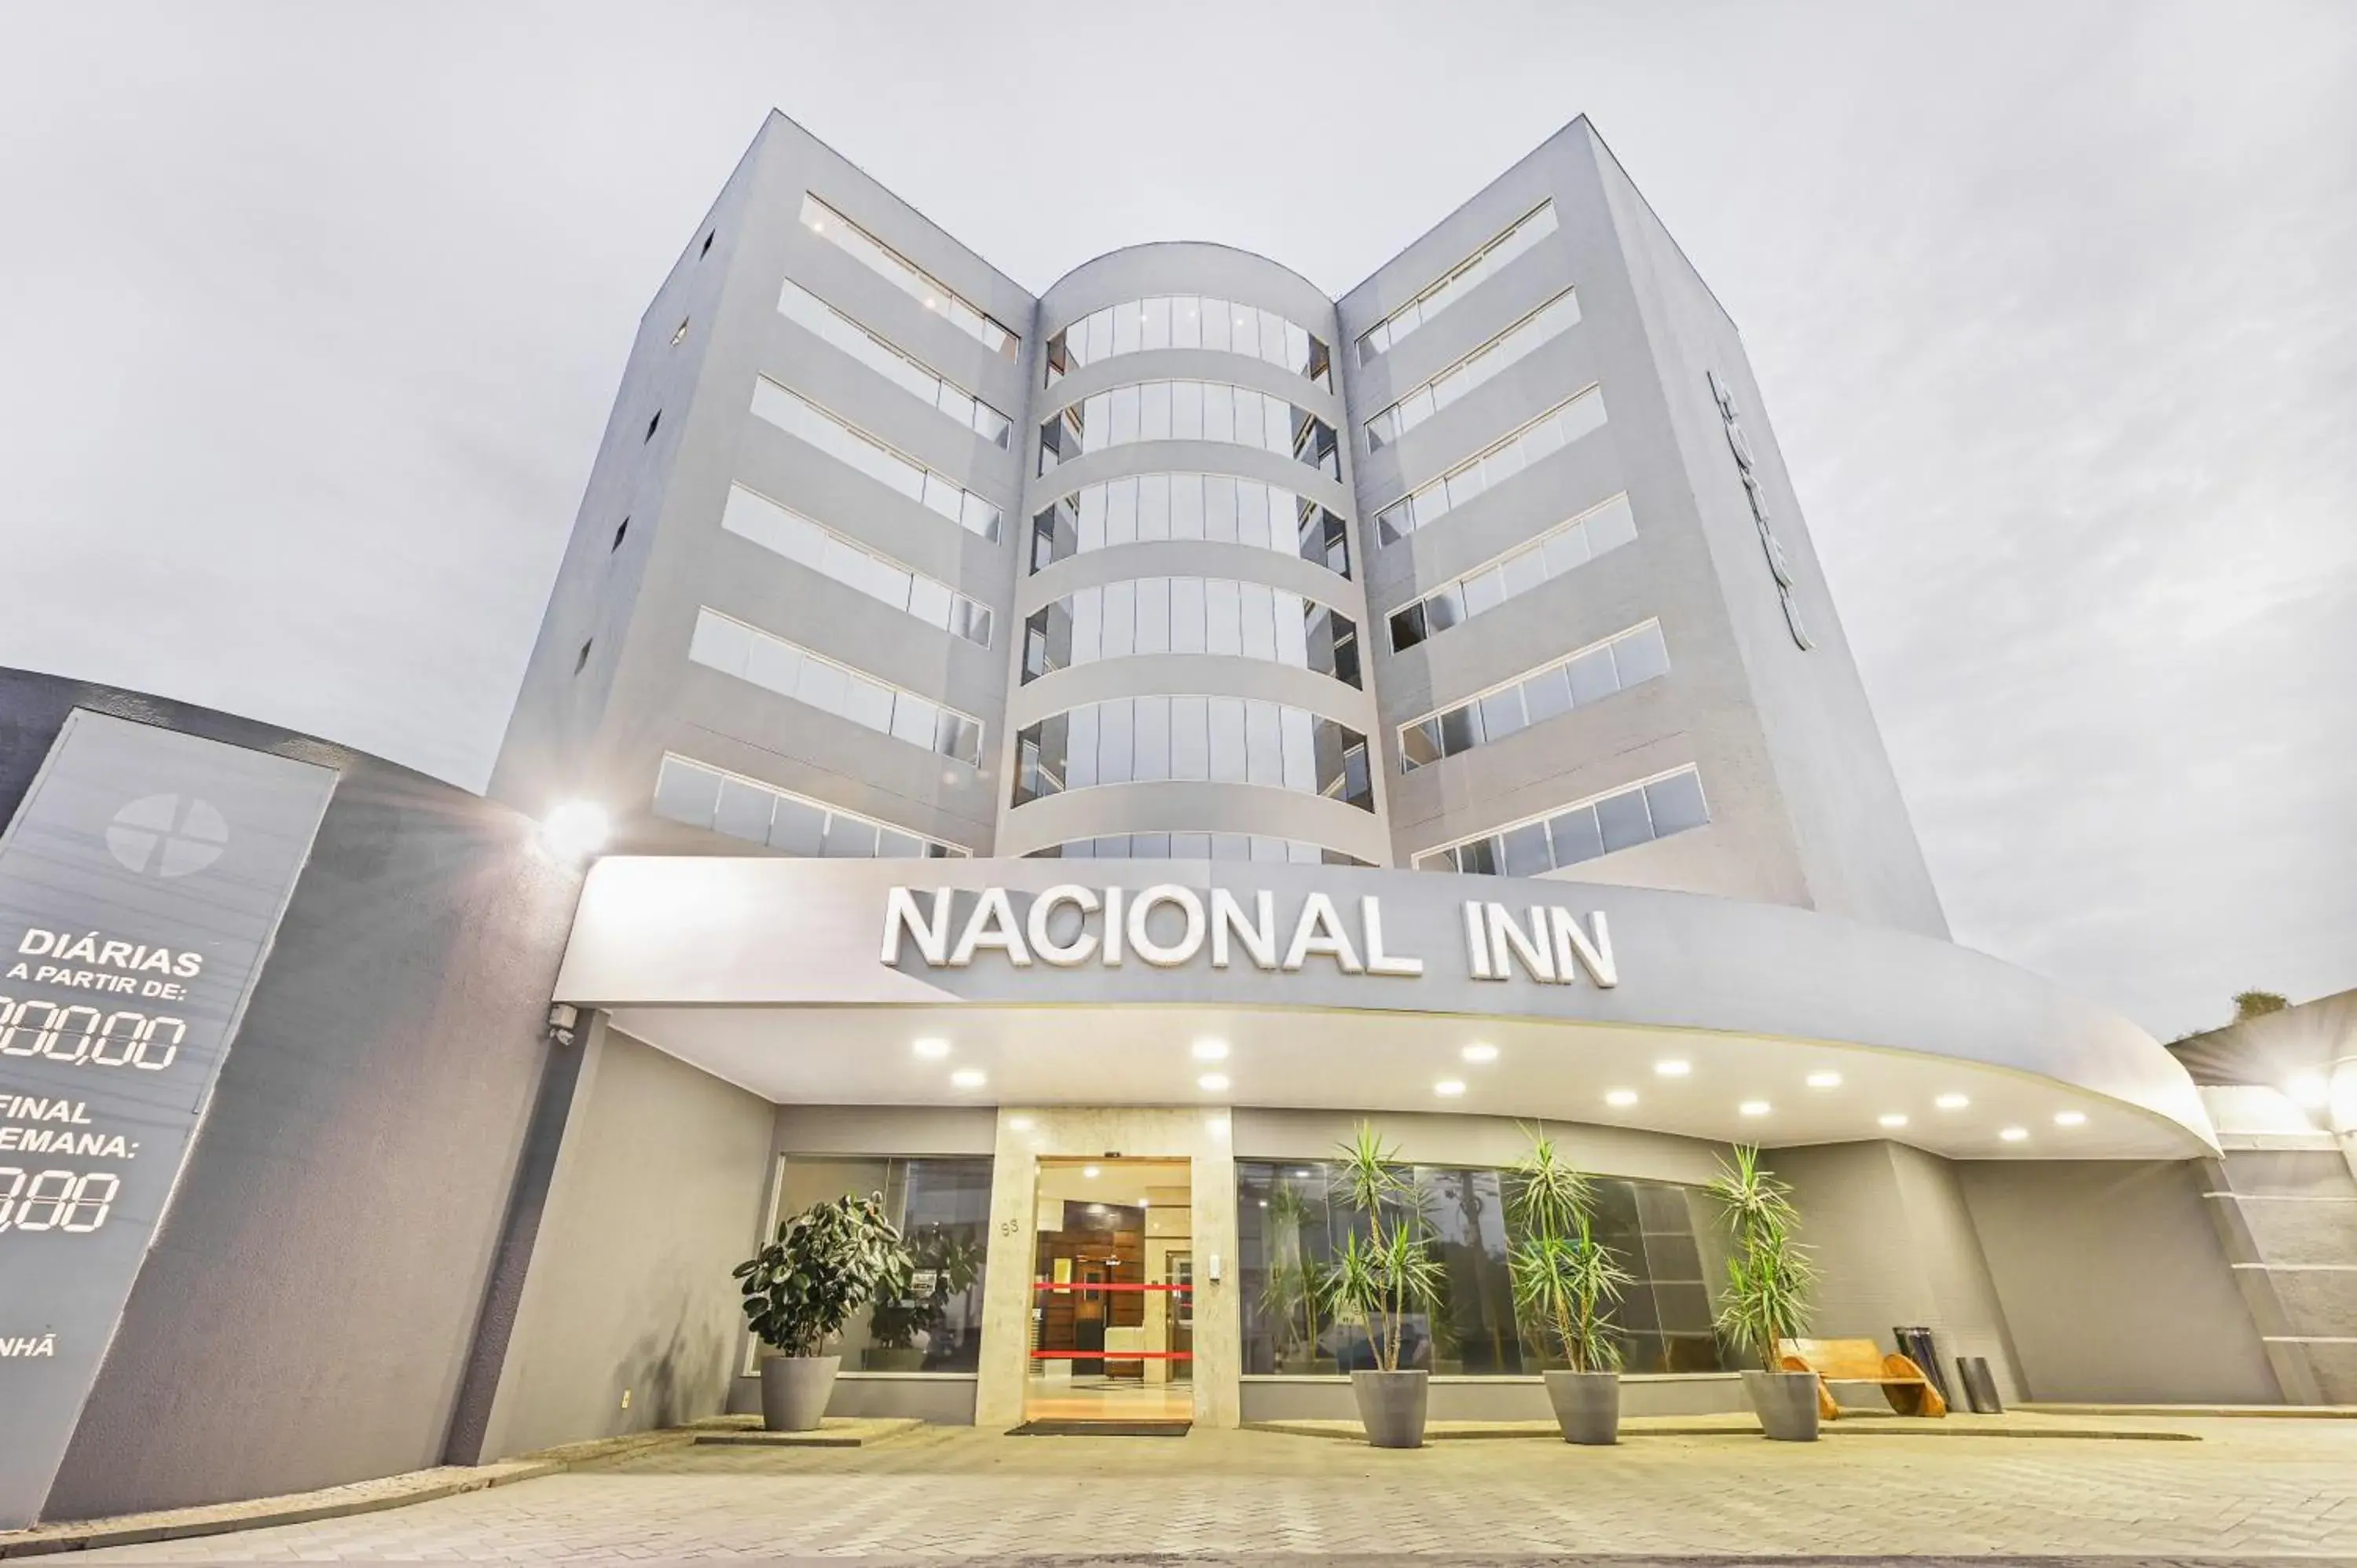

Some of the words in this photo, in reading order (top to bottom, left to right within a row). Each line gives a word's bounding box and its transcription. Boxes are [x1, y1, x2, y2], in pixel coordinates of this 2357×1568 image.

[18, 928, 203, 978] DIÁRIAS
[880, 884, 1423, 976] NACIONAL
[1461, 899, 1618, 988] INN
[6, 962, 28, 980] A
[35, 965, 137, 994] PARTIR
[141, 980, 188, 1001] DE:
